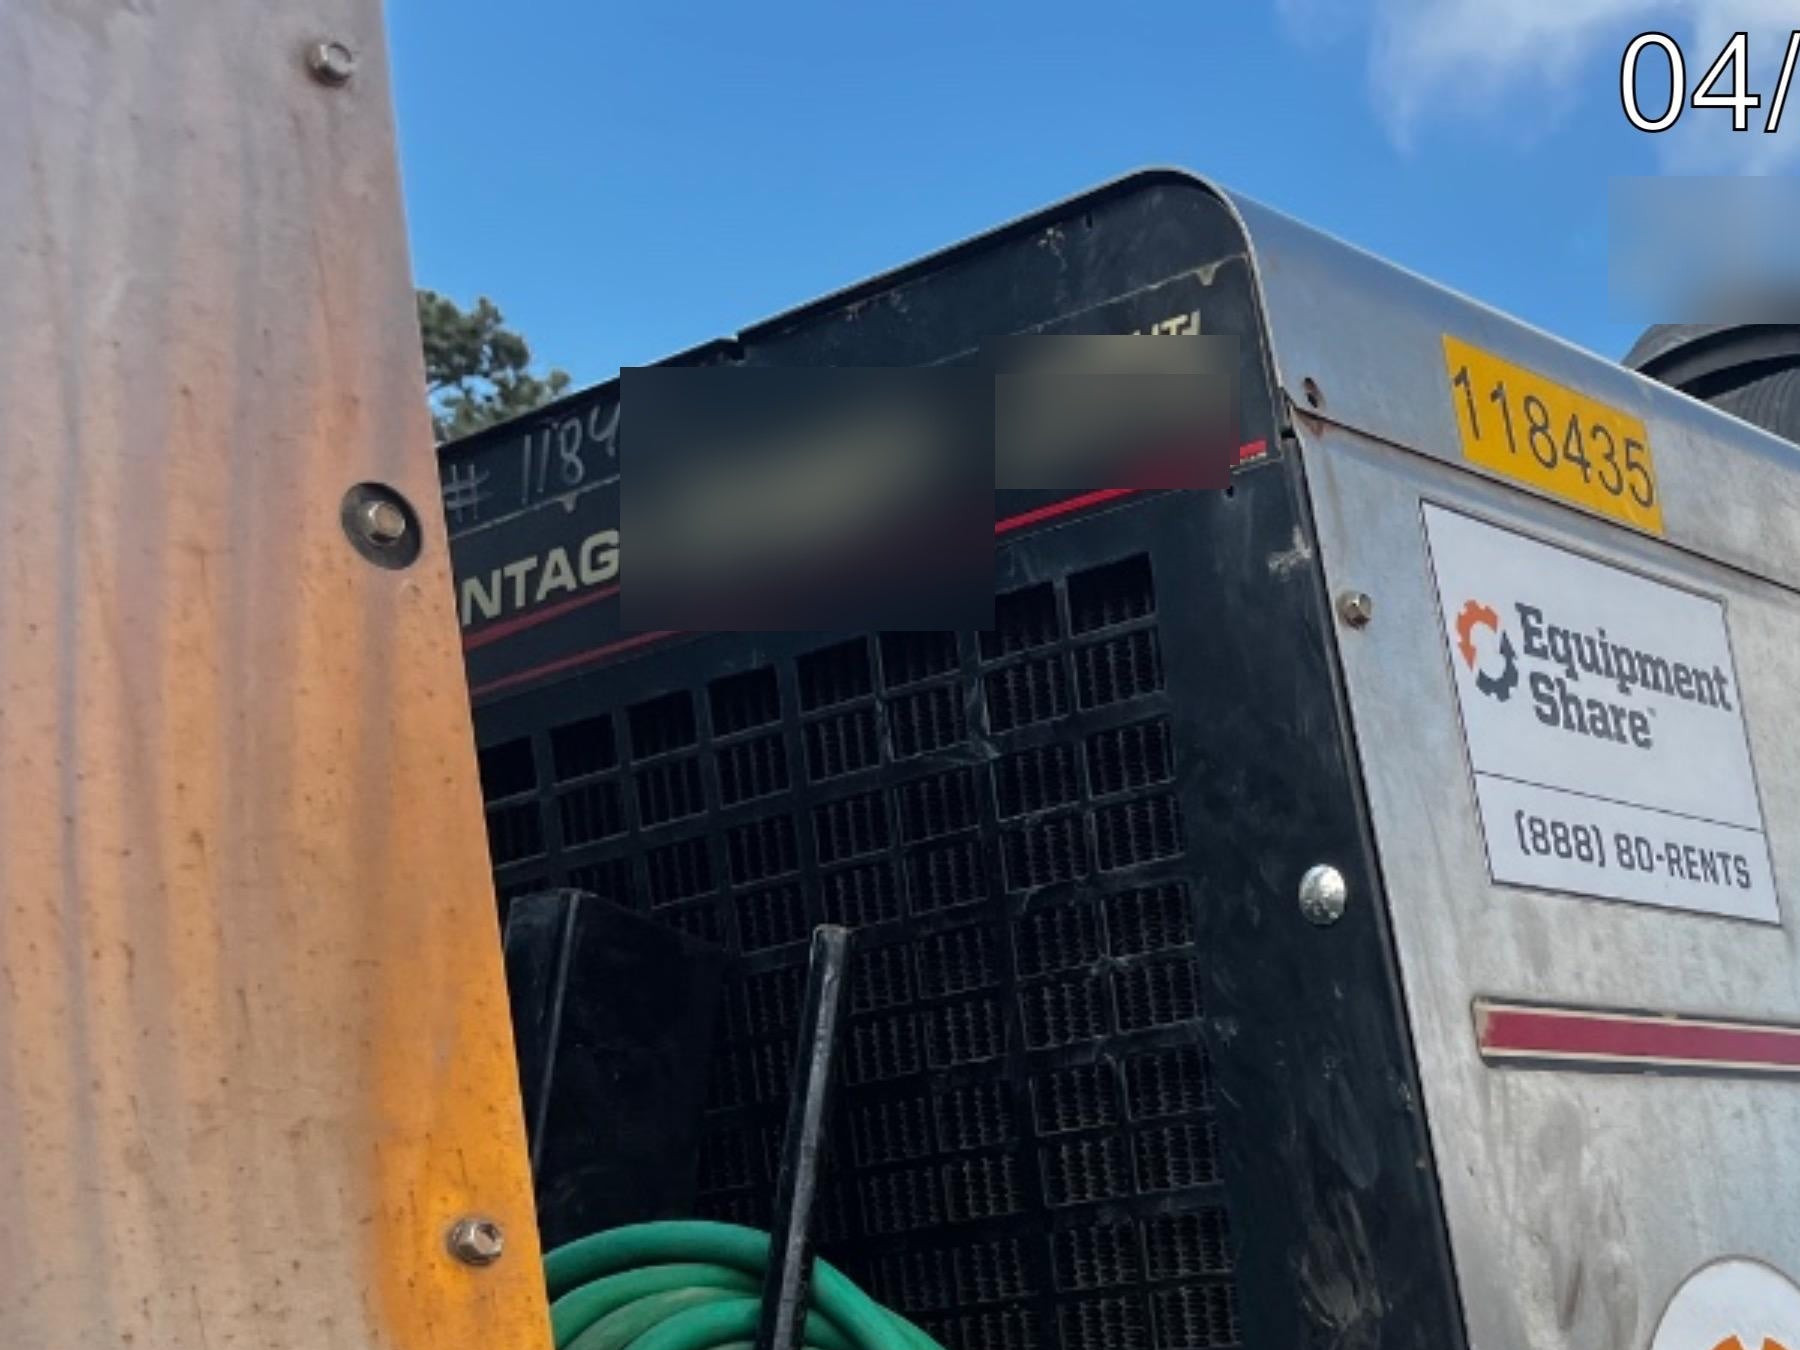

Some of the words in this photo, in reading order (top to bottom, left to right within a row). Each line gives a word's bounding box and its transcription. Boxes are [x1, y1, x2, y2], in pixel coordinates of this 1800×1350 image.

[1454, 365, 1653, 508] 118435
[1515, 602, 1732, 711] Equipment
[1530, 671, 1654, 750] Share
[1515, 810, 1605, 867] (888)
[1614, 833, 1751, 888] 80-RENTS
